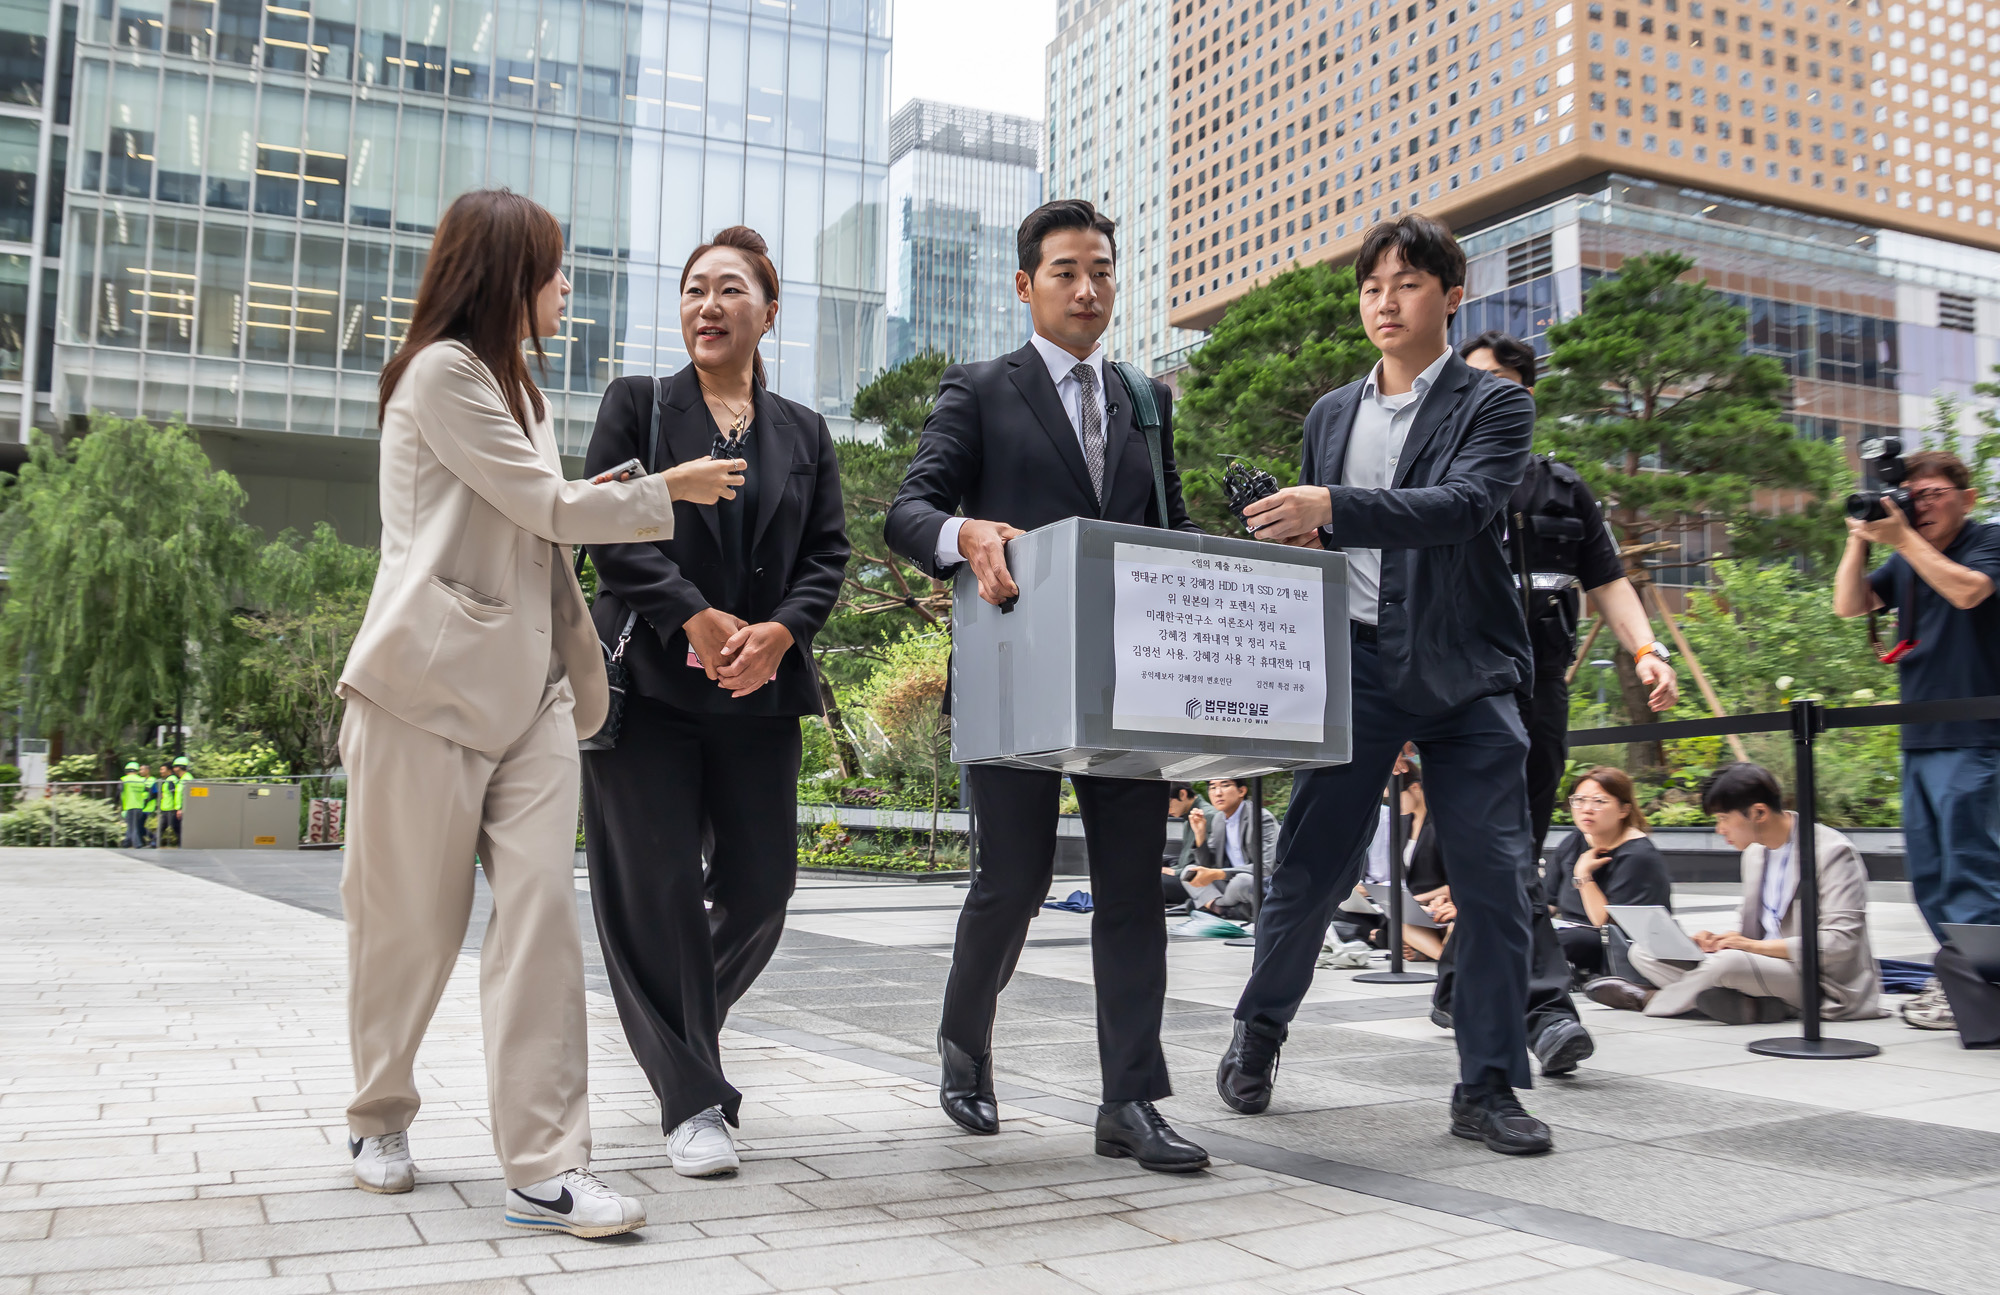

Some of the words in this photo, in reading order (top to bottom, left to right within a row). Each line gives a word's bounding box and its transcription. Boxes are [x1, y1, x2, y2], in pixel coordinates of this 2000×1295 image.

[1191, 558, 1210, 569] <임의
[1214, 561, 1230, 572] 제출
[1234, 563, 1253, 573] 자료>
[1131, 571, 1158, 584] 명태균
[1161, 574, 1173, 584] PC
[1177, 576, 1186, 587] 및
[1190, 577, 1215, 590] 강혜경
[1218, 580, 1238, 591] HDD
[1242, 583, 1254, 595] 1개
[1257, 585, 1274, 596] SSD
[1276, 587, 1290, 599] 2개
[1293, 589, 1309, 601] 원본
[1168, 593, 1176, 605] 위
[1182, 594, 1209, 608] 원본의
[1215, 598, 1224, 610] 각
[1229, 600, 1256, 613] 포렌식
[1260, 603, 1277, 614] 자료
[1146, 609, 1213, 626] 미래한국연구소
[1217, 616, 1254, 631] 여론조사
[1258, 621, 1275, 633] 정리
[1279, 623, 1296, 634] 자료
[1158, 629, 1187, 643] 강혜경
[1192, 632, 1229, 646] 계좌내역
[1235, 636, 1243, 647] 및
[1247, 637, 1265, 650] 정리
[1269, 640, 1287, 651] 자료
[1132, 645, 1160, 658] 김영선
[1193, 650, 1220, 663] 강혜경
[1225, 653, 1243, 666] 사용
[1247, 655, 1255, 666] 각
[1260, 656, 1293, 670] 휴대전화
[1298, 660, 1311, 672] 1대
[1141, 671, 1174, 681] 공익제보자
[1177, 673, 1204, 684] 강혜경의
[1206, 676, 1232, 686] 변호인단
[1205, 699, 1269, 717] 법무법인일로
